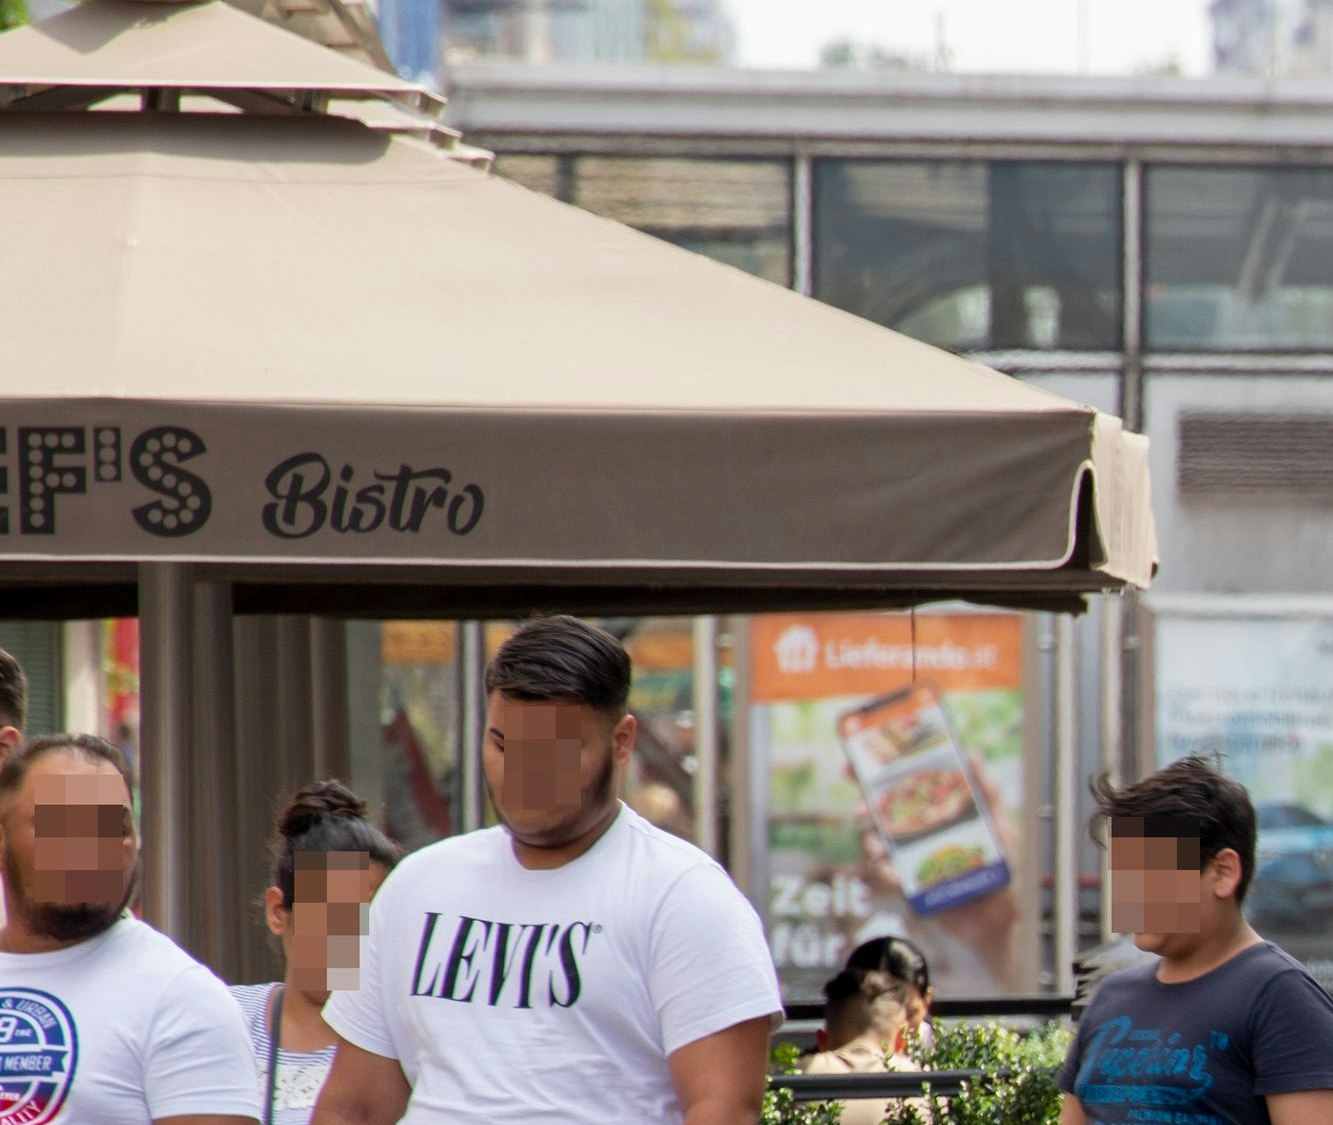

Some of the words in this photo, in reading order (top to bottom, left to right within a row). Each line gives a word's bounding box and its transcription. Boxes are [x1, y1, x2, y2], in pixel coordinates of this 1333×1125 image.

[0, 426, 213, 538] F'S
[262, 452, 485, 540] Bistro
[771, 874, 871, 918] Zeit
[409, 911, 593, 1009] LEVI'S
[16, 999, 57, 1029] URBAN
[4, 1056, 52, 1071] MEMBER
